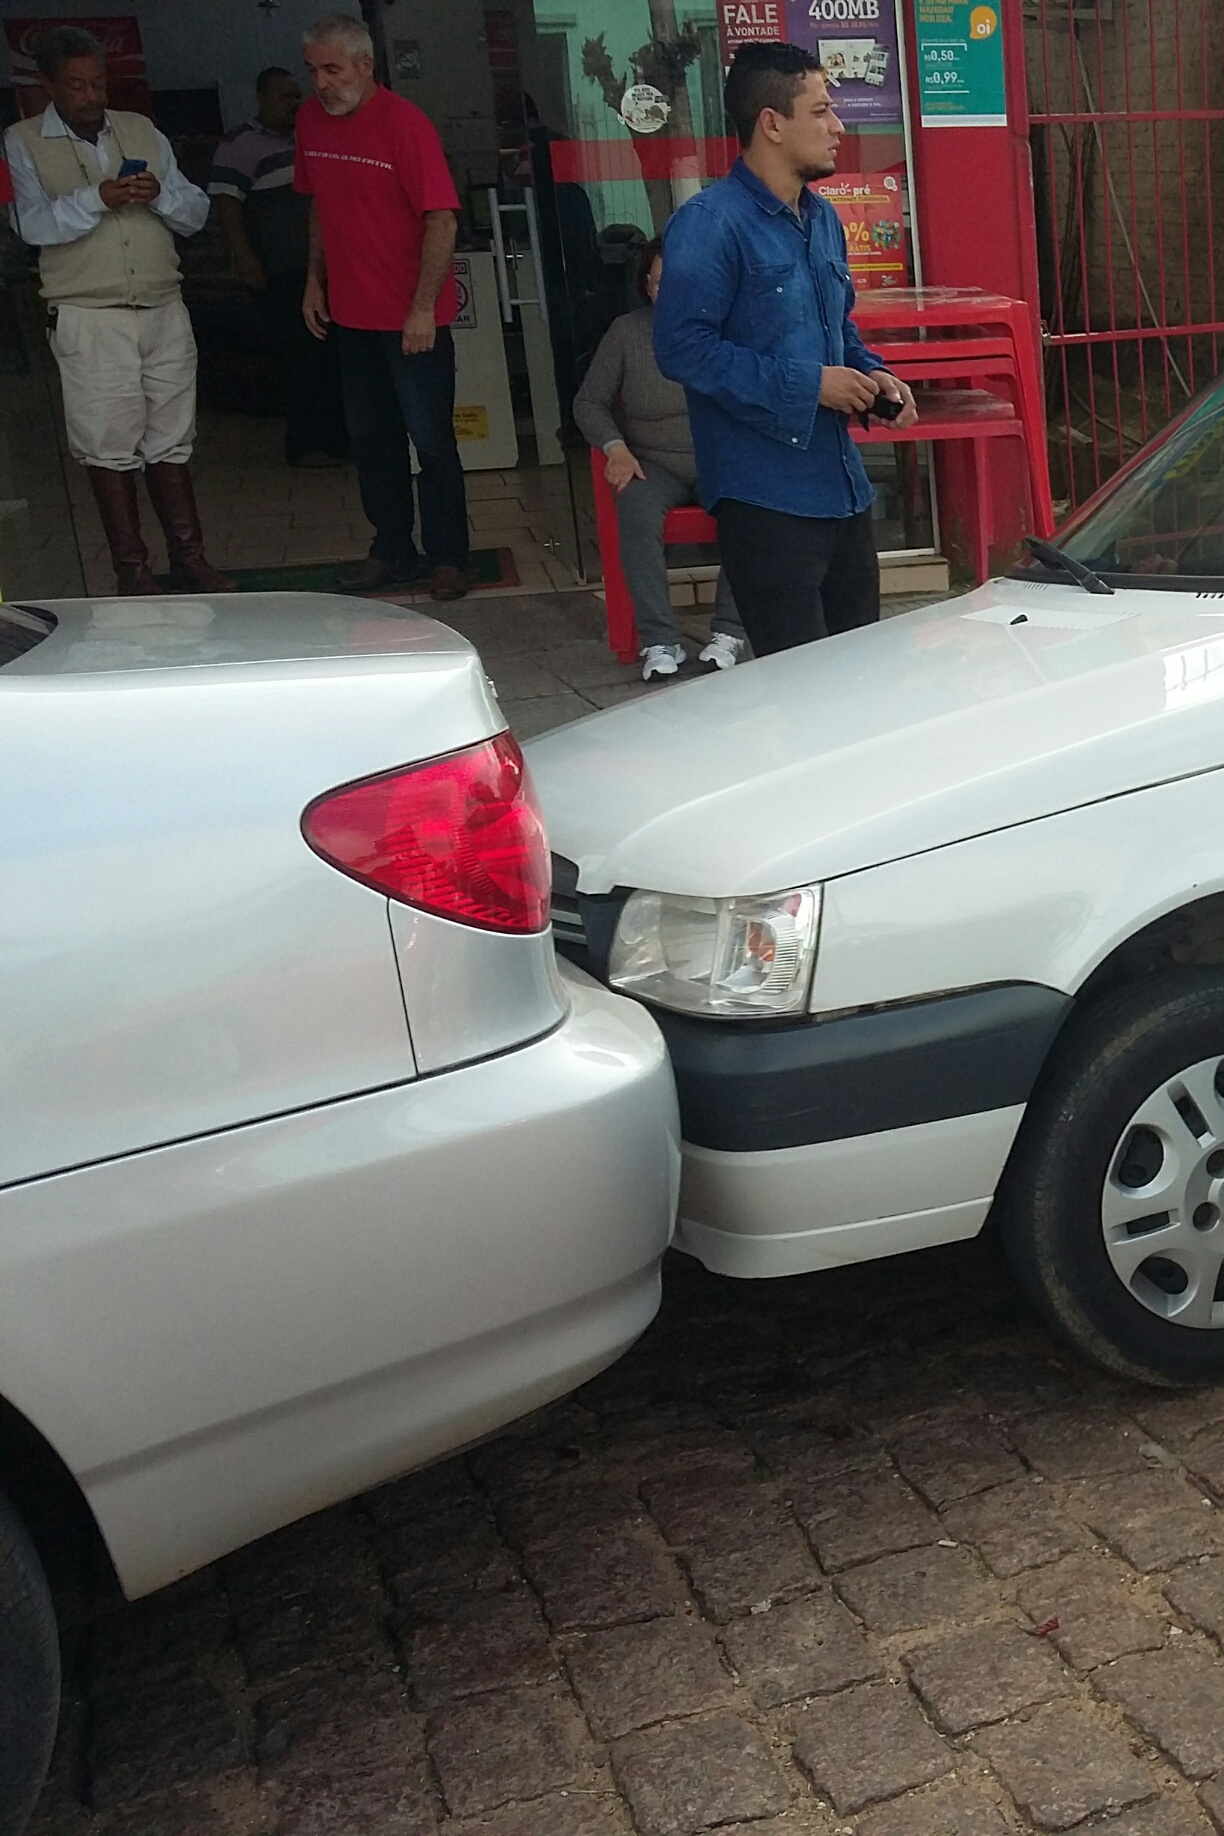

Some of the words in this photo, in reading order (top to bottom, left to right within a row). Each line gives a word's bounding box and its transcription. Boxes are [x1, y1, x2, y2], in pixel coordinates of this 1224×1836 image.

[723, 3, 779, 24] FALE
[808, 0, 880, 20] 400MB
[726, 24, 734, 37] À
[734, 26, 780, 36] VONTADE
[976, 18, 991, 35] oi
[853, 184, 871, 197] pré
